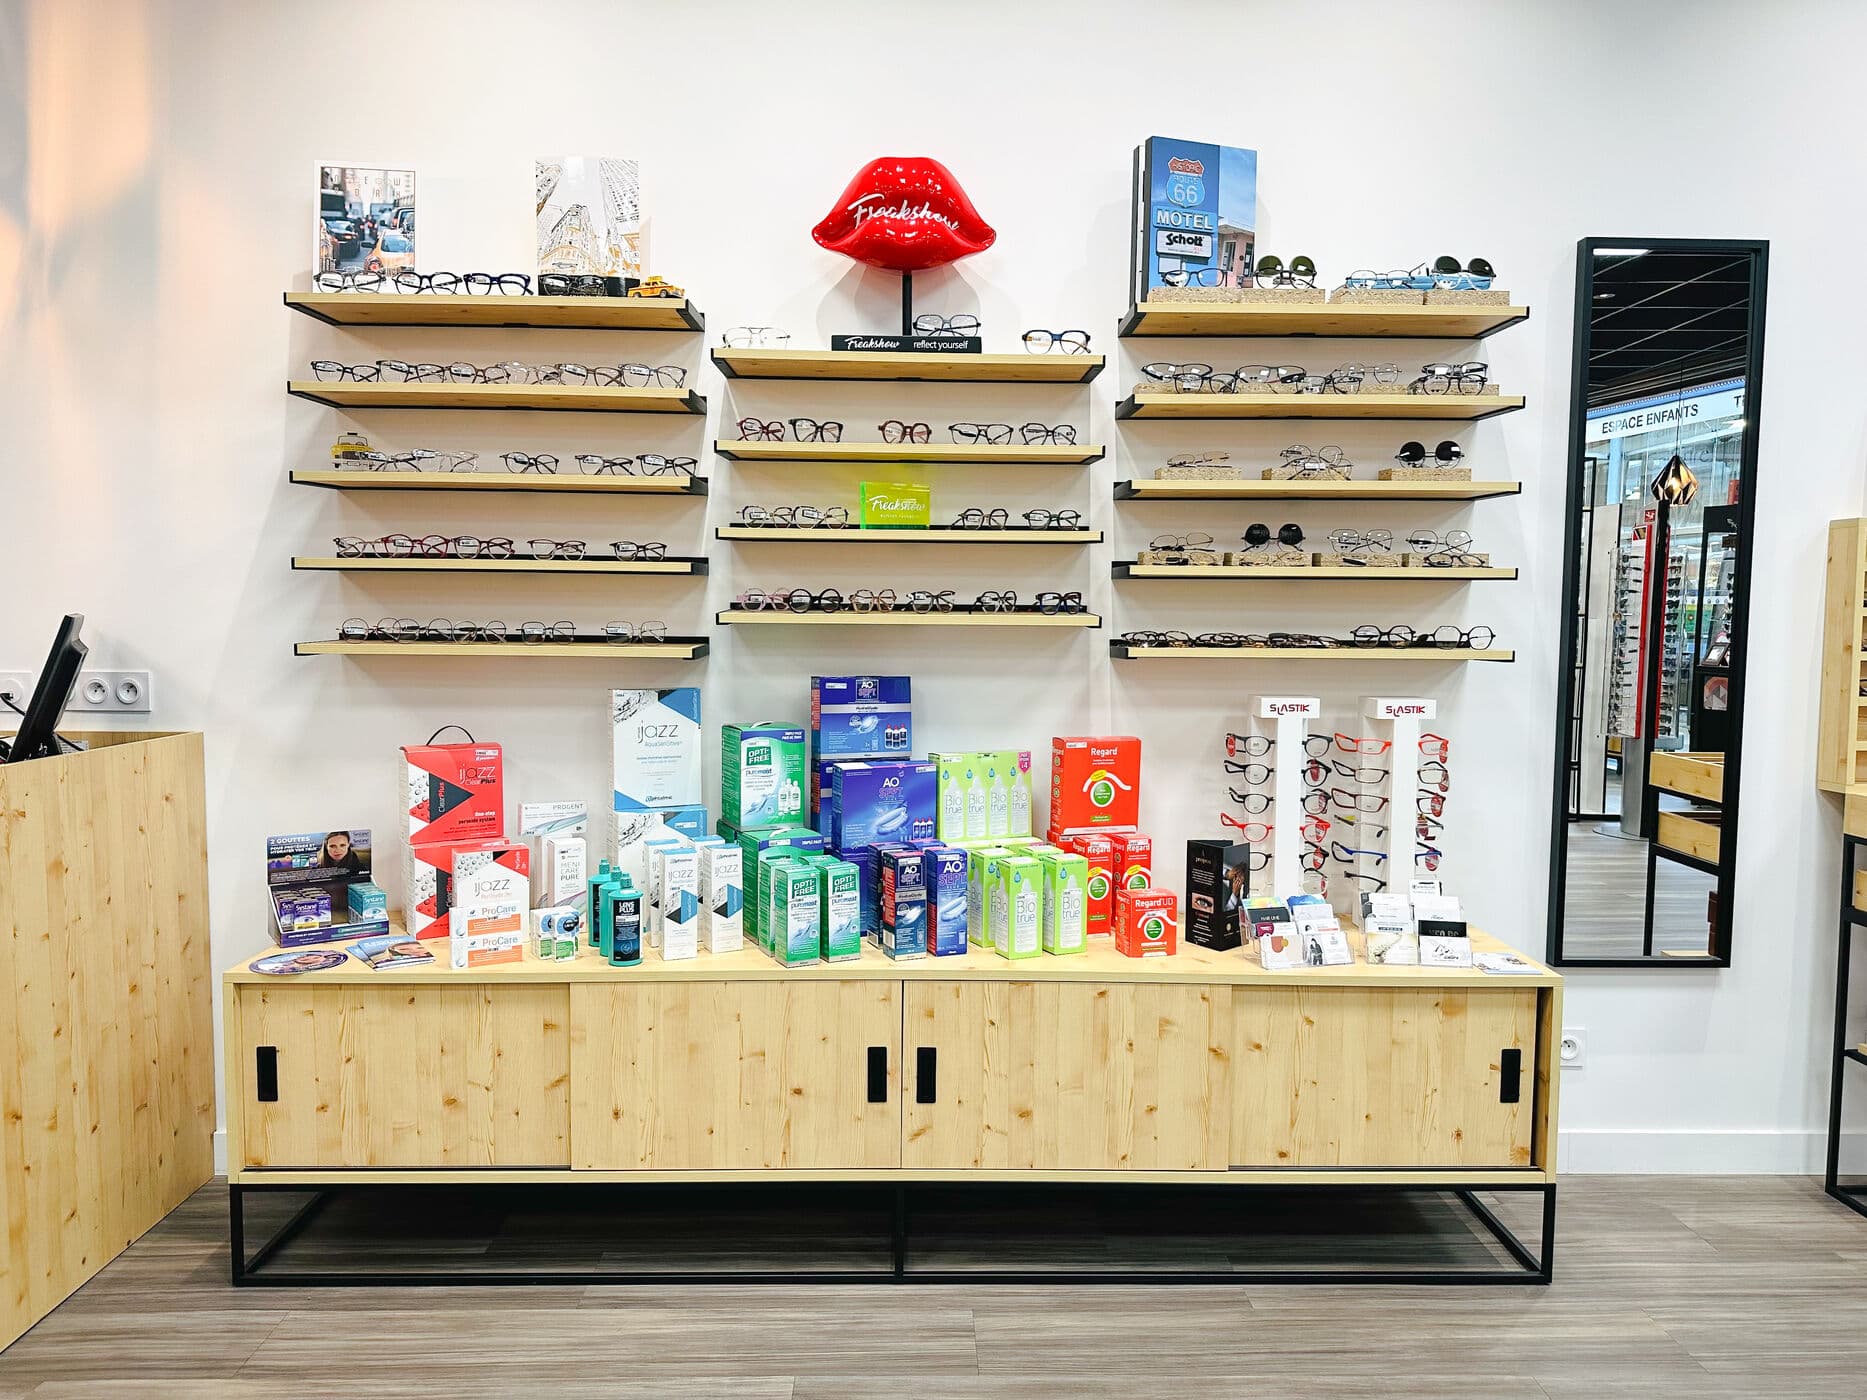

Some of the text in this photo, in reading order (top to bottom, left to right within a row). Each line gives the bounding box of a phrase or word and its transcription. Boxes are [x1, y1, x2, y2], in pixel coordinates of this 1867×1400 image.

[1174, 183, 1198, 203] 66
[847, 193, 959, 229] Freakshow
[1157, 209, 1213, 230] MOTEL
[1166, 233, 1204, 246] Schott
[845, 336, 969, 351] Freakshow reflect yourself
[1602, 414, 1643, 434] ESPACE
[1646, 403, 1699, 426] ENFANTS
[869, 495, 926, 512] Freakshow
[1269, 703, 1310, 715] SLASTIK
[1385, 705, 1426, 717] SLASTIK
[1090, 747, 1118, 757] Regard
[883, 777, 900, 788] AO
[1087, 846, 1111, 854] Regard
[1126, 844, 1150, 852] Regard
[904, 866, 917, 874] AO
[943, 861, 962, 873] AO
[793, 880, 815, 889] OPTI-
[834, 875, 855, 886] OPTI-
[939, 872, 967, 886] SEPT
[795, 886, 815, 896] FREE
[835, 881, 855, 892] FREE
[1016, 900, 1036, 914] Bio
[1063, 896, 1081, 910] Bio
[1135, 897, 1174, 908] Regard UD
[481, 905, 517, 915] ProCare
[1063, 909, 1081, 920] true
[1016, 912, 1036, 924] true
[483, 936, 518, 946] ProCare
